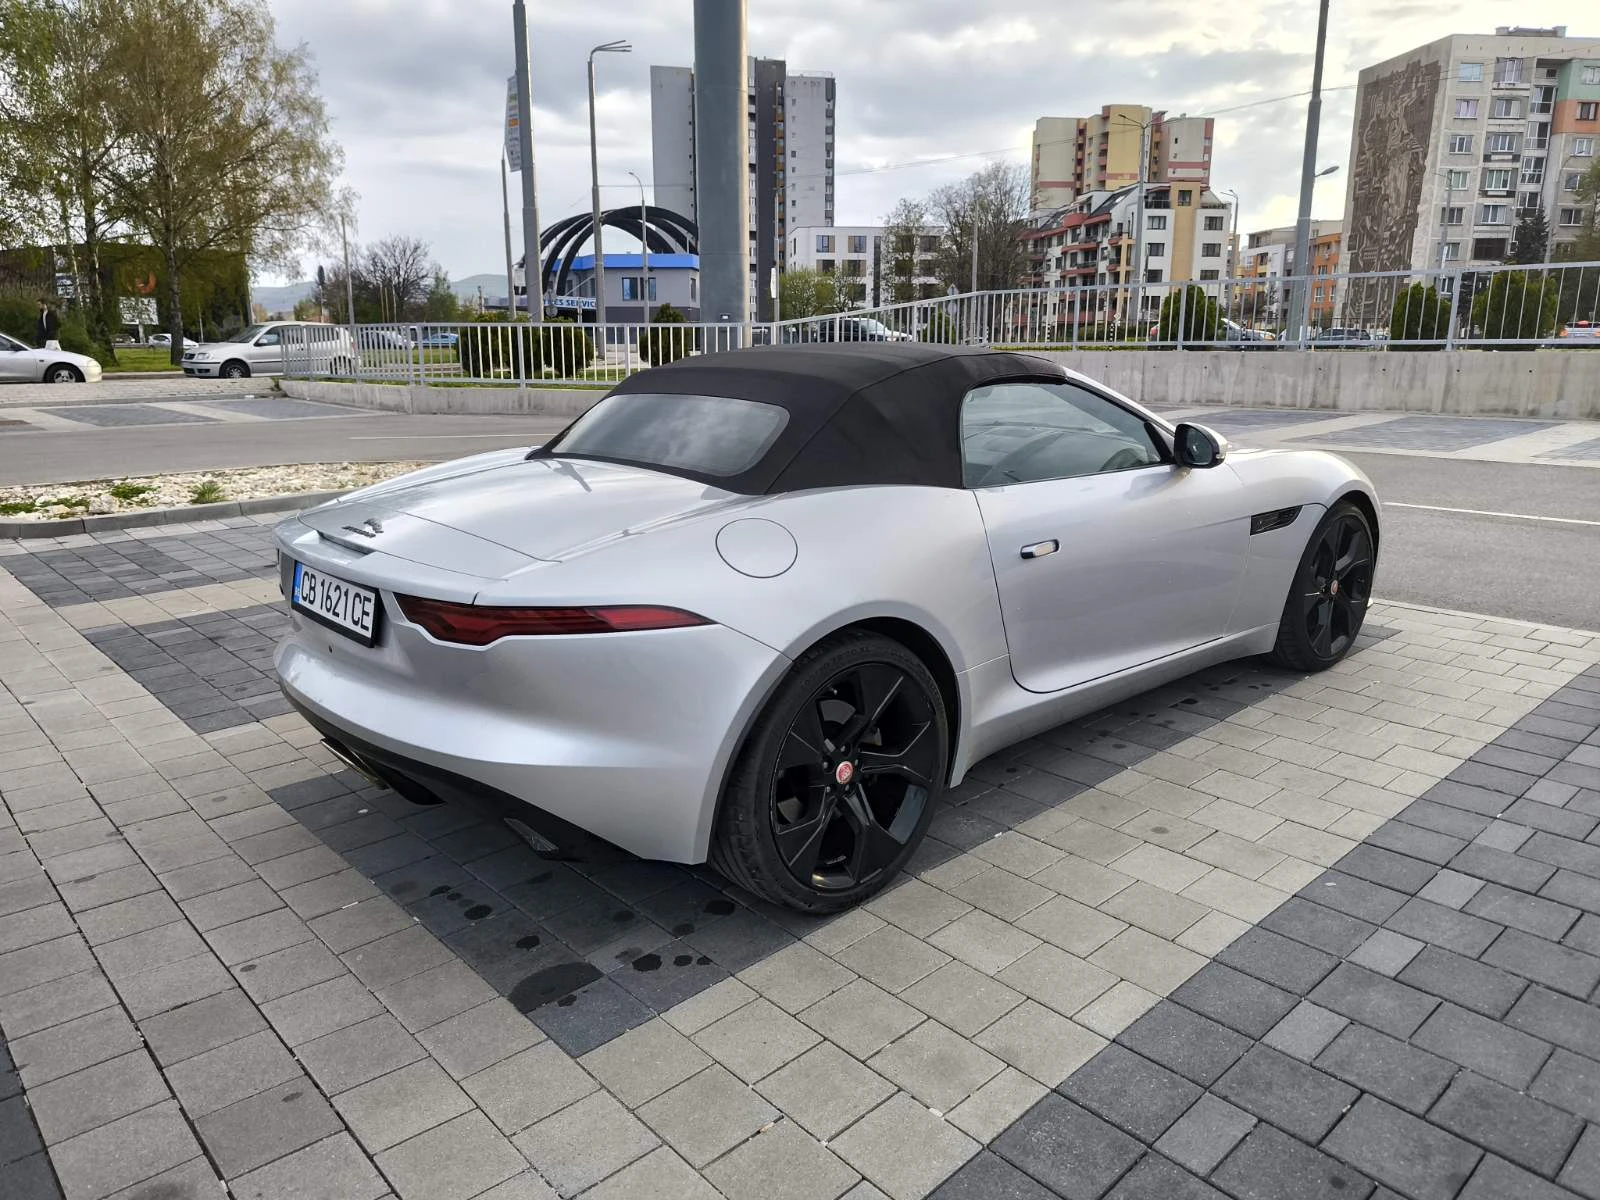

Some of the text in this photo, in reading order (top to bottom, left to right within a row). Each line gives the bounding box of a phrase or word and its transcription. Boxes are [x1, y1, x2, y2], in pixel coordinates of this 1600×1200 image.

[566, 299, 597, 308] SEVIC
[301, 571, 372, 632] CB 1621 CE
